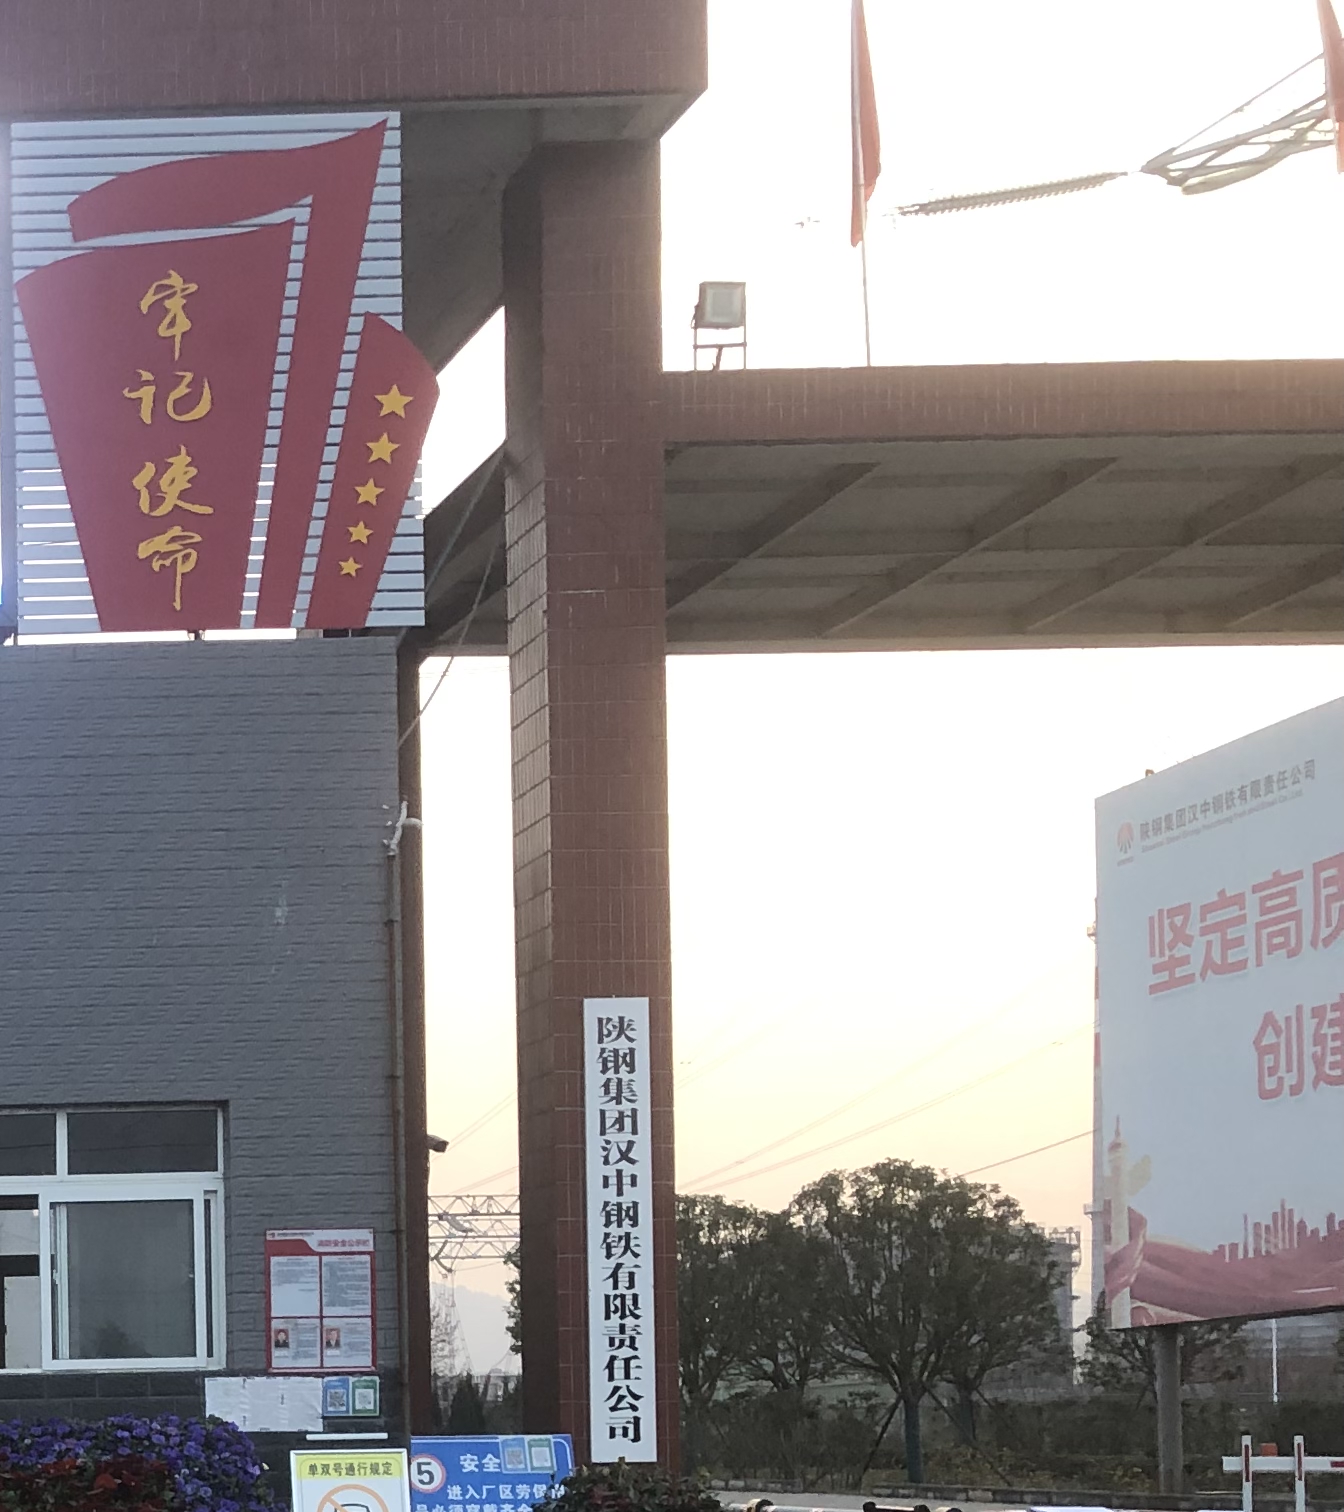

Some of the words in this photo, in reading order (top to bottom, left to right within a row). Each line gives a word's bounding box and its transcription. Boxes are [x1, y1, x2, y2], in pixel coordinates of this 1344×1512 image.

[123, 270, 214, 611] 牢记使命
[1139, 759, 1315, 842] 陕钢集团汉中钢铁有限责任公司
[596, 1015, 644, 1444] 陕钢集团汉中钢铁有限责任公司
[308, 1462, 393, 1477] 单双号通行规定
[416, 1461, 435, 1486] 5
[459, 1453, 502, 1473] 安全
